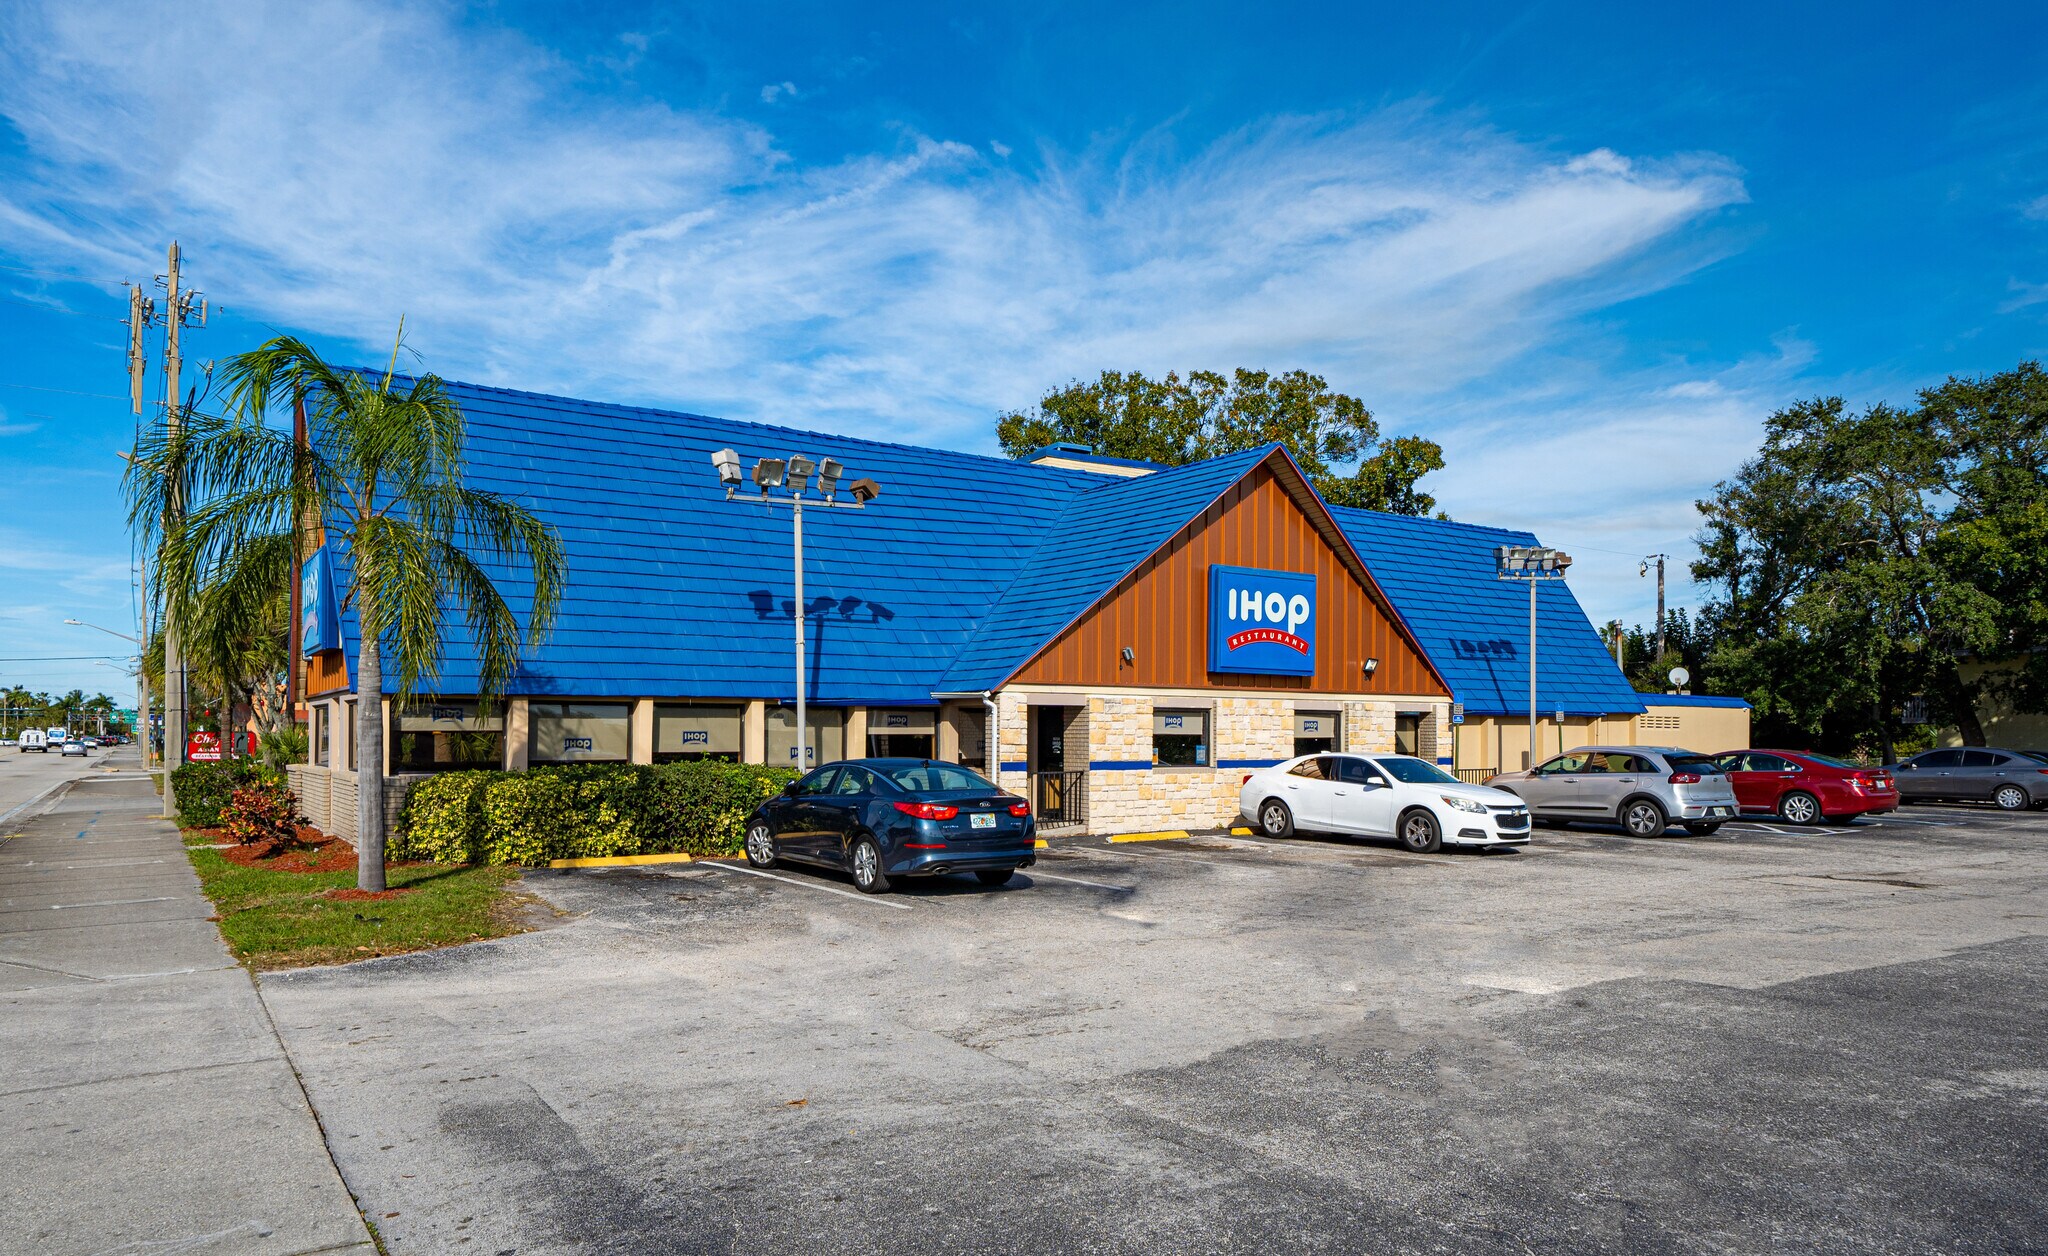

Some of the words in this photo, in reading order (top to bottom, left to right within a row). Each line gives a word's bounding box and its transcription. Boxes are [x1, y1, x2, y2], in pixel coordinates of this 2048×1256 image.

[1228, 588, 1310, 635] IHOP
[1232, 632, 1305, 650] RESTAURANT
[888, 716, 907, 725] IHOP
[684, 732, 707, 742] IHOP
[565, 739, 591, 749] IHOP
